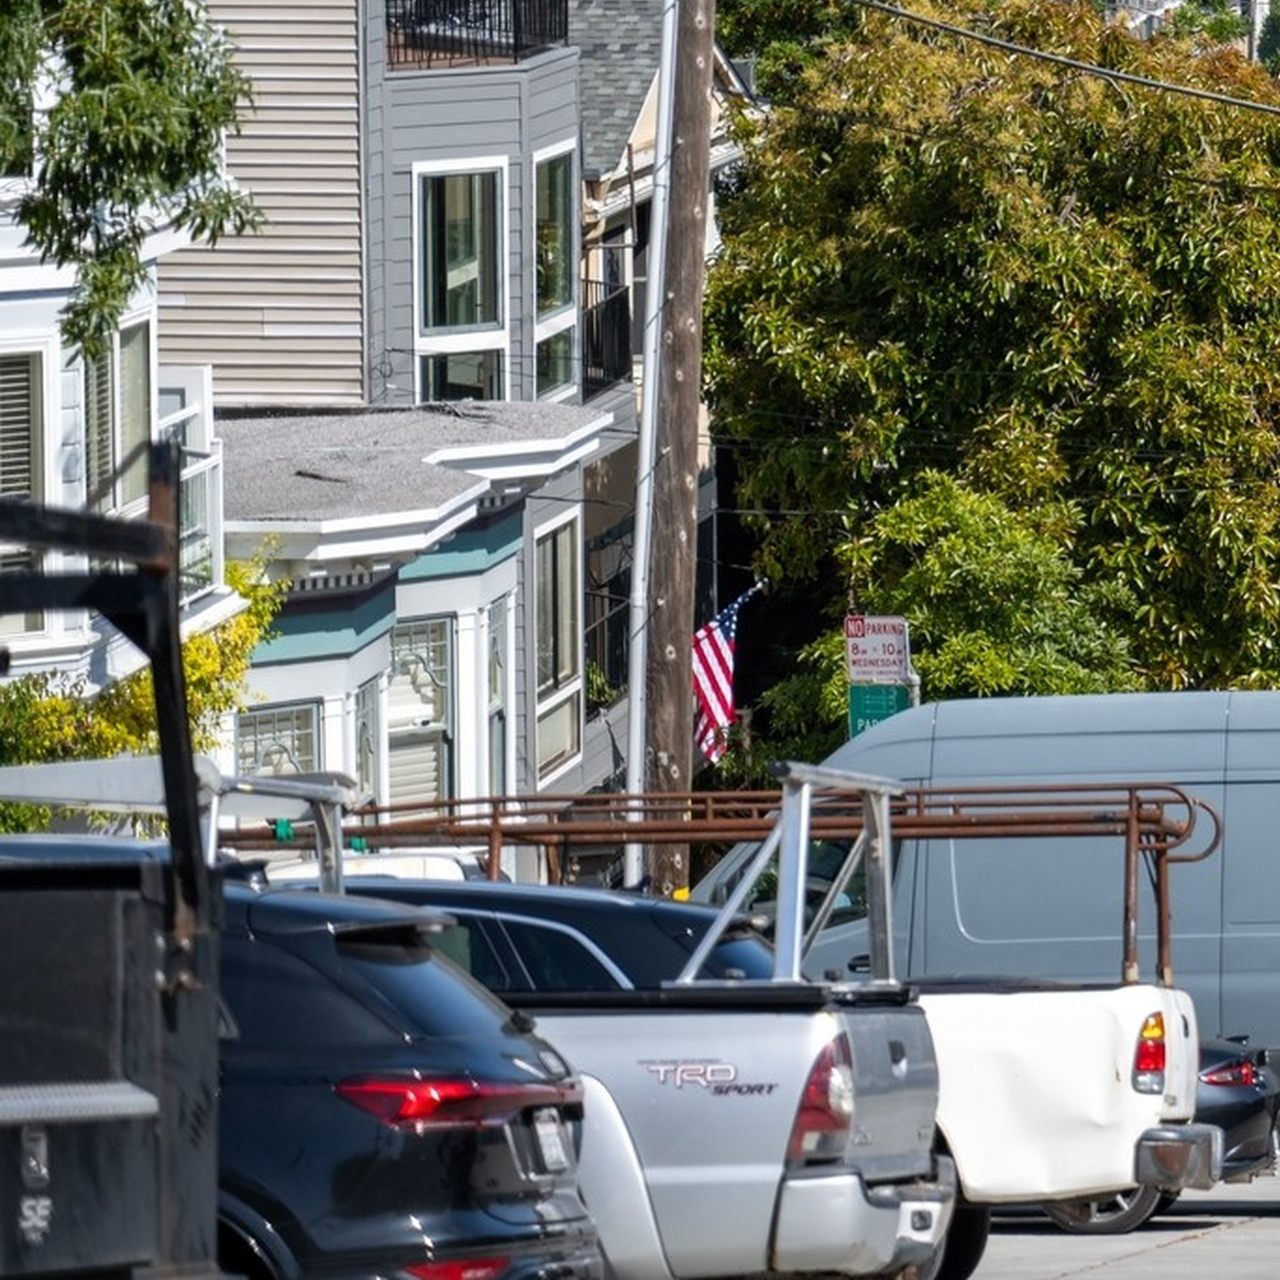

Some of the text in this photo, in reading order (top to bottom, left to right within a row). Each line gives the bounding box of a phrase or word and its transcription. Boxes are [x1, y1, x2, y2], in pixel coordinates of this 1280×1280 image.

[847, 619, 904, 636] NO PARKING
[851, 658, 903, 668] WEDNESDAY
[648, 1063, 738, 1089] TRD
[711, 1083, 779, 1096] SPORT
